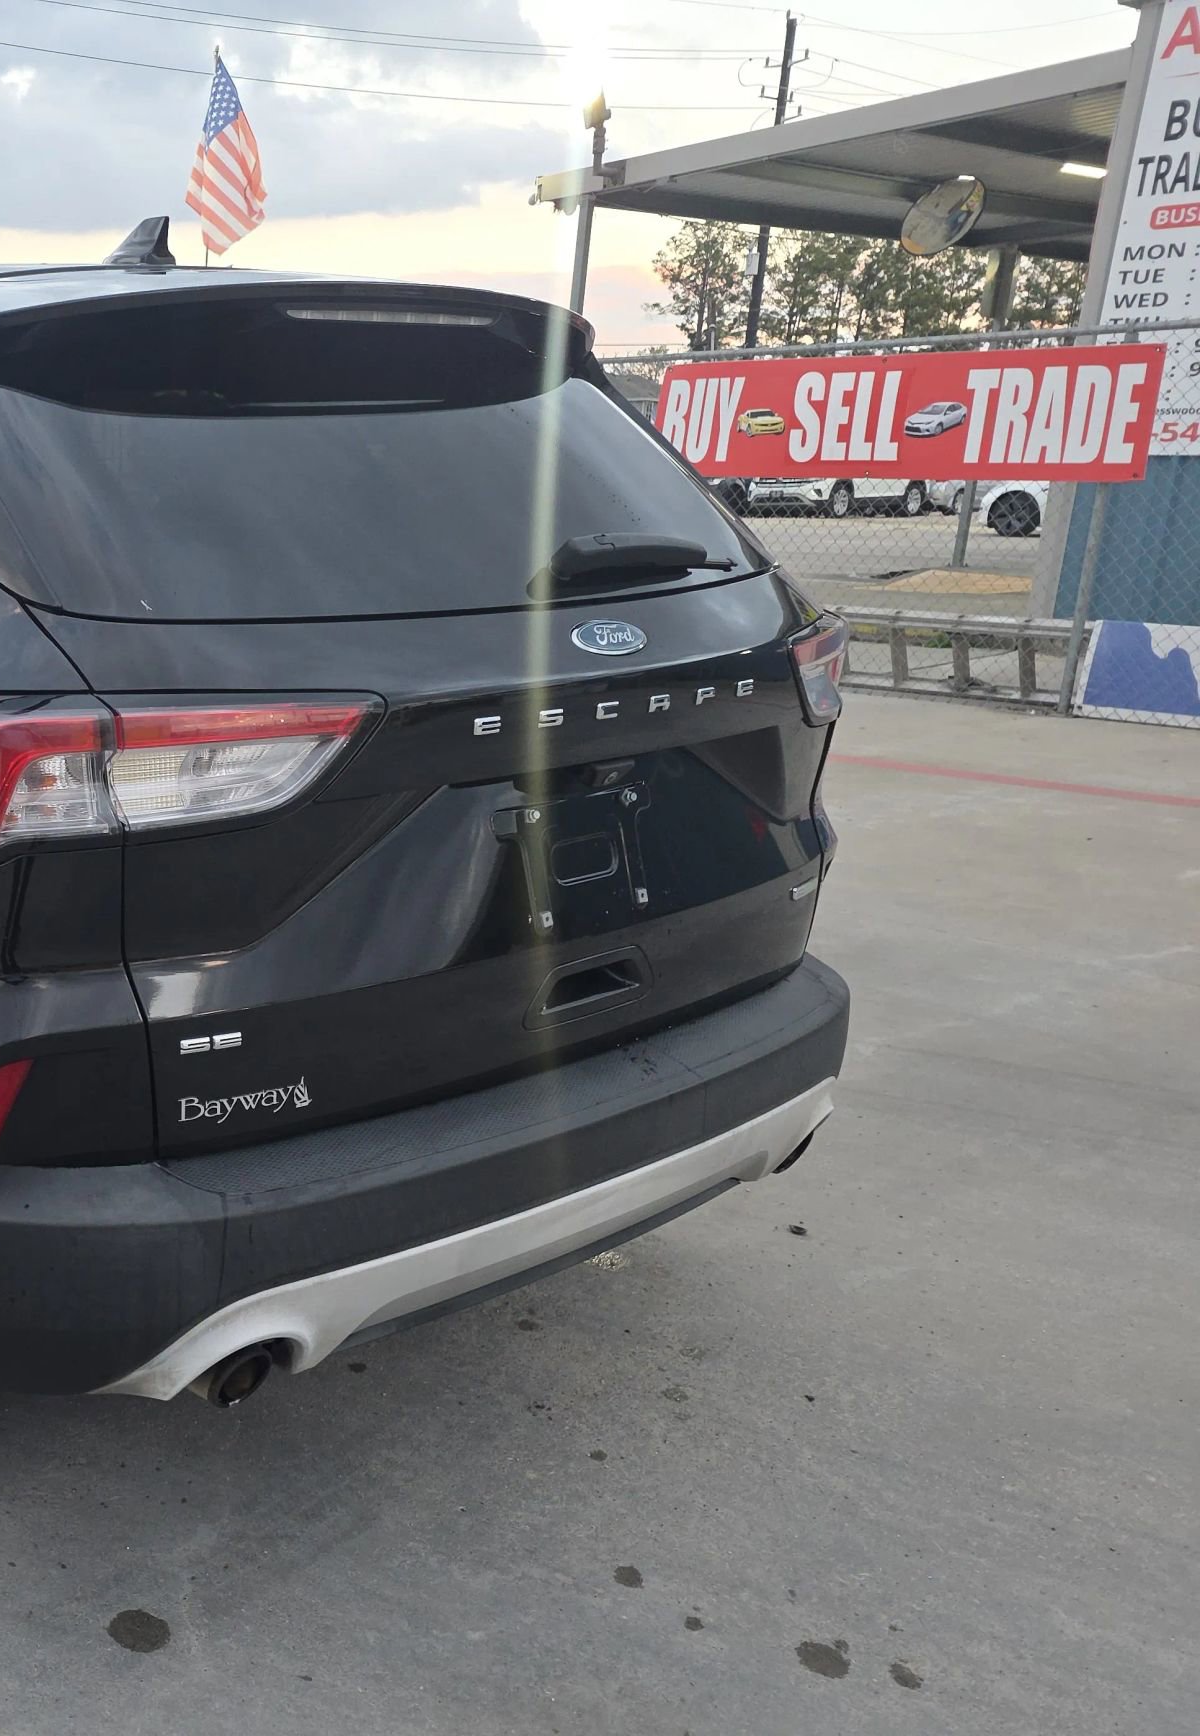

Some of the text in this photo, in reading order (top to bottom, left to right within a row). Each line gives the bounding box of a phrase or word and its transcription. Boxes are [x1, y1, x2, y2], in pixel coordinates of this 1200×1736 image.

[1156, 207, 1200, 225] BUS
[1123, 242, 1186, 262] MON
[1119, 268, 1166, 285] TUE
[1114, 292, 1169, 309] WED
[662, 362, 1148, 464] BUY SELL TRADE
[593, 624, 636, 645] Ford
[473, 678, 754, 736] ESCAPE
[179, 1031, 242, 1055] SE
[178, 1085, 296, 1124] Bayway
